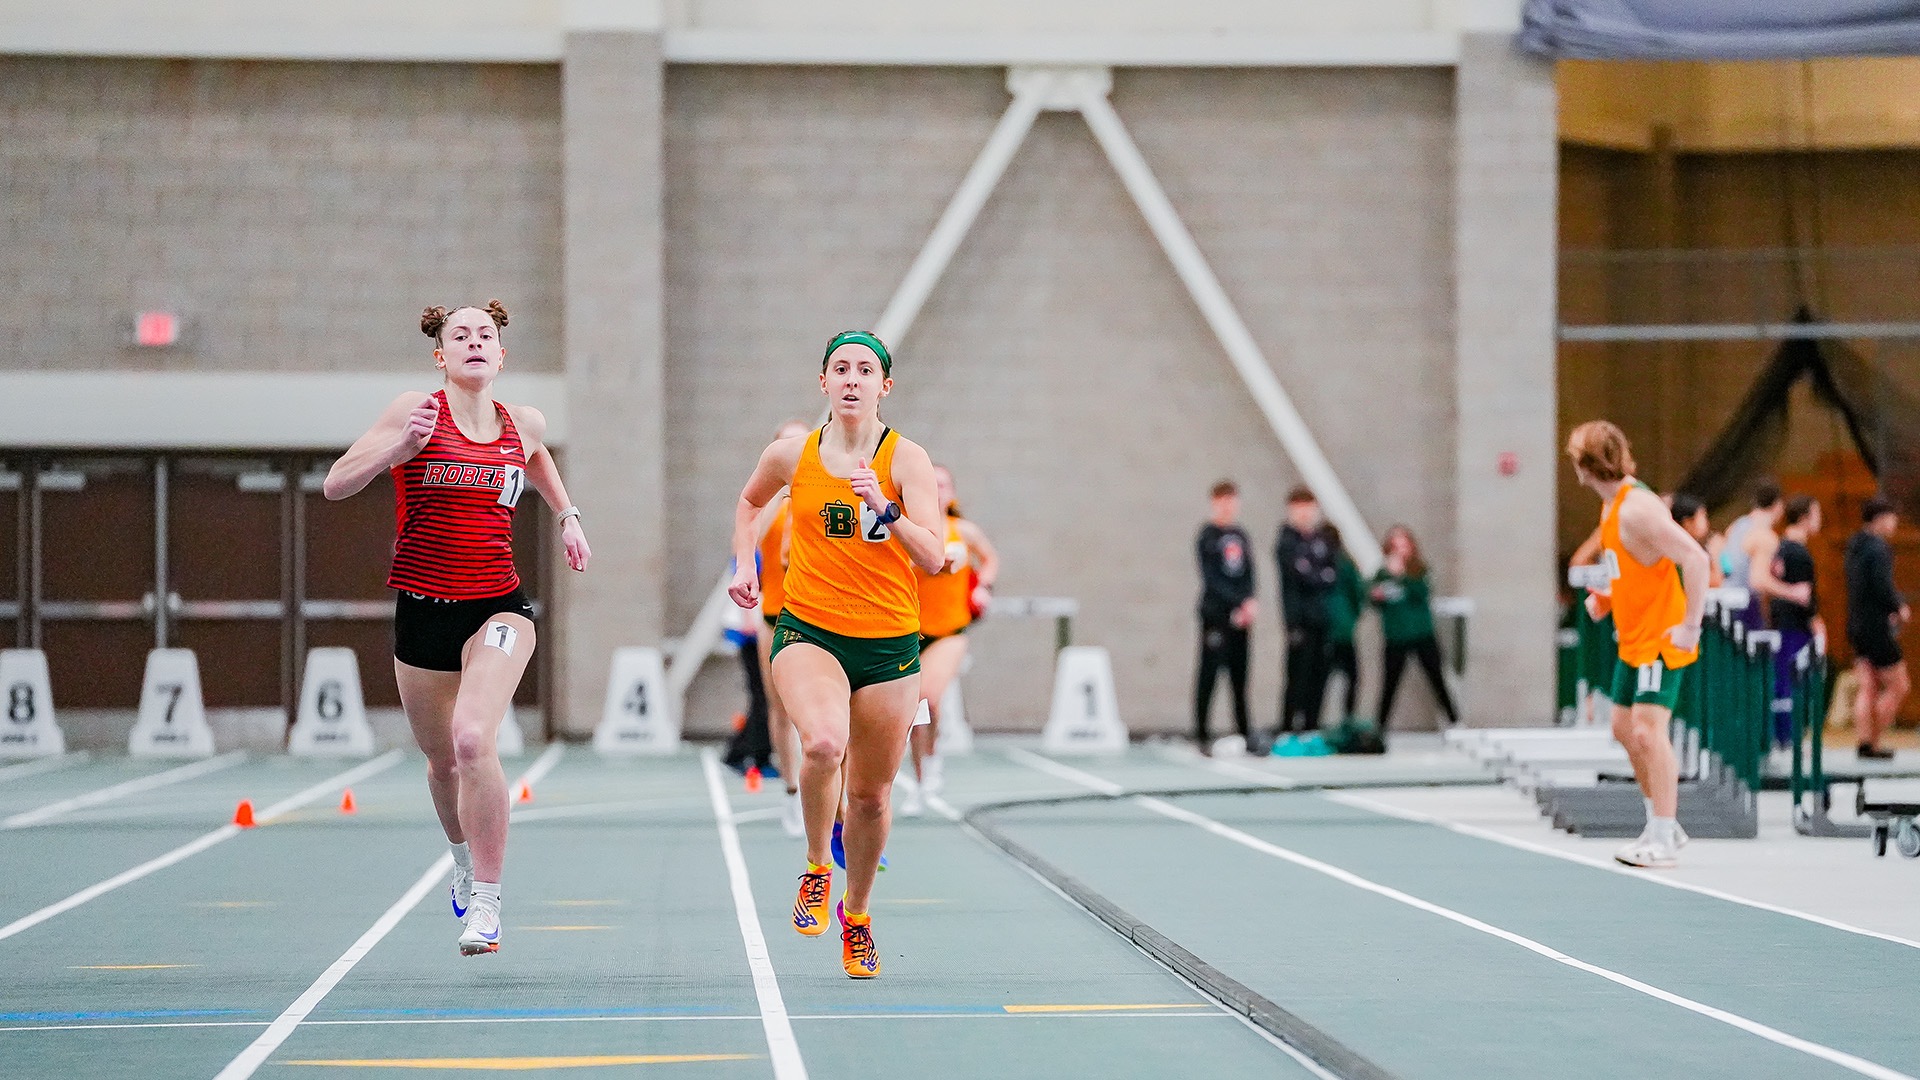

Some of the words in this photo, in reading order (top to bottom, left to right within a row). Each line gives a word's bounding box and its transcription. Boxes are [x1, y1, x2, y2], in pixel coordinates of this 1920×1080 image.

[510, 468, 520, 505] 1
[825, 503, 856, 538] B
[866, 506, 885, 540] 2
[496, 625, 509, 648] 1
[9, 682, 34, 723] 8
[157, 684, 182, 722] 7
[318, 680, 343, 721] 6
[623, 682, 648, 717] 4
